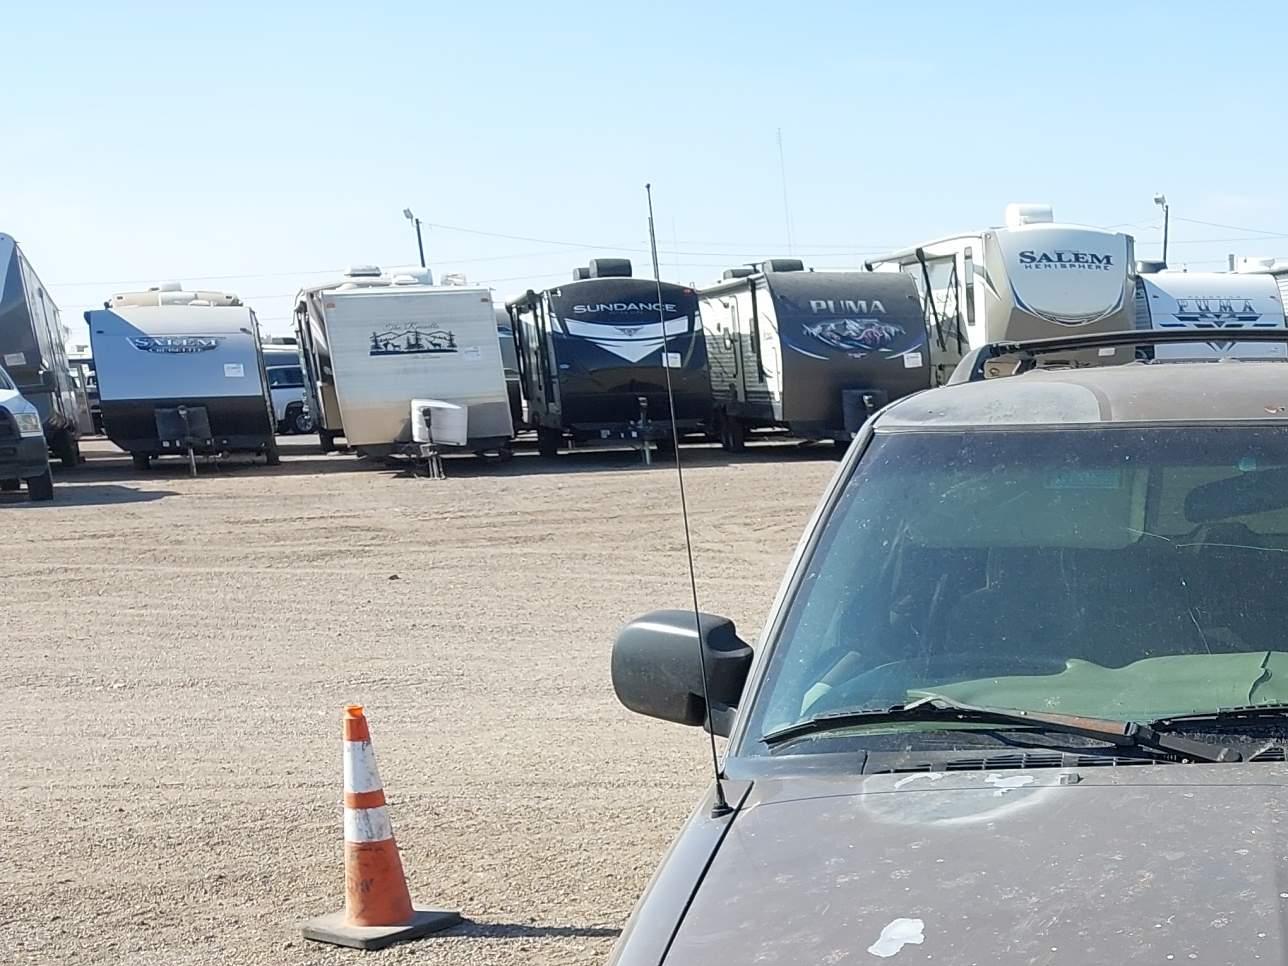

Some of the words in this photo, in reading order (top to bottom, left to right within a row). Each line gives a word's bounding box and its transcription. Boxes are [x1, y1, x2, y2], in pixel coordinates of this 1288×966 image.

[1019, 251, 1114, 266] SALEM
[1024, 263, 1111, 271] HEMISPHERE
[572, 302, 678, 314] SUNDANCE
[809, 299, 887, 314] PUMA
[1176, 299, 1257, 313] PUMA
